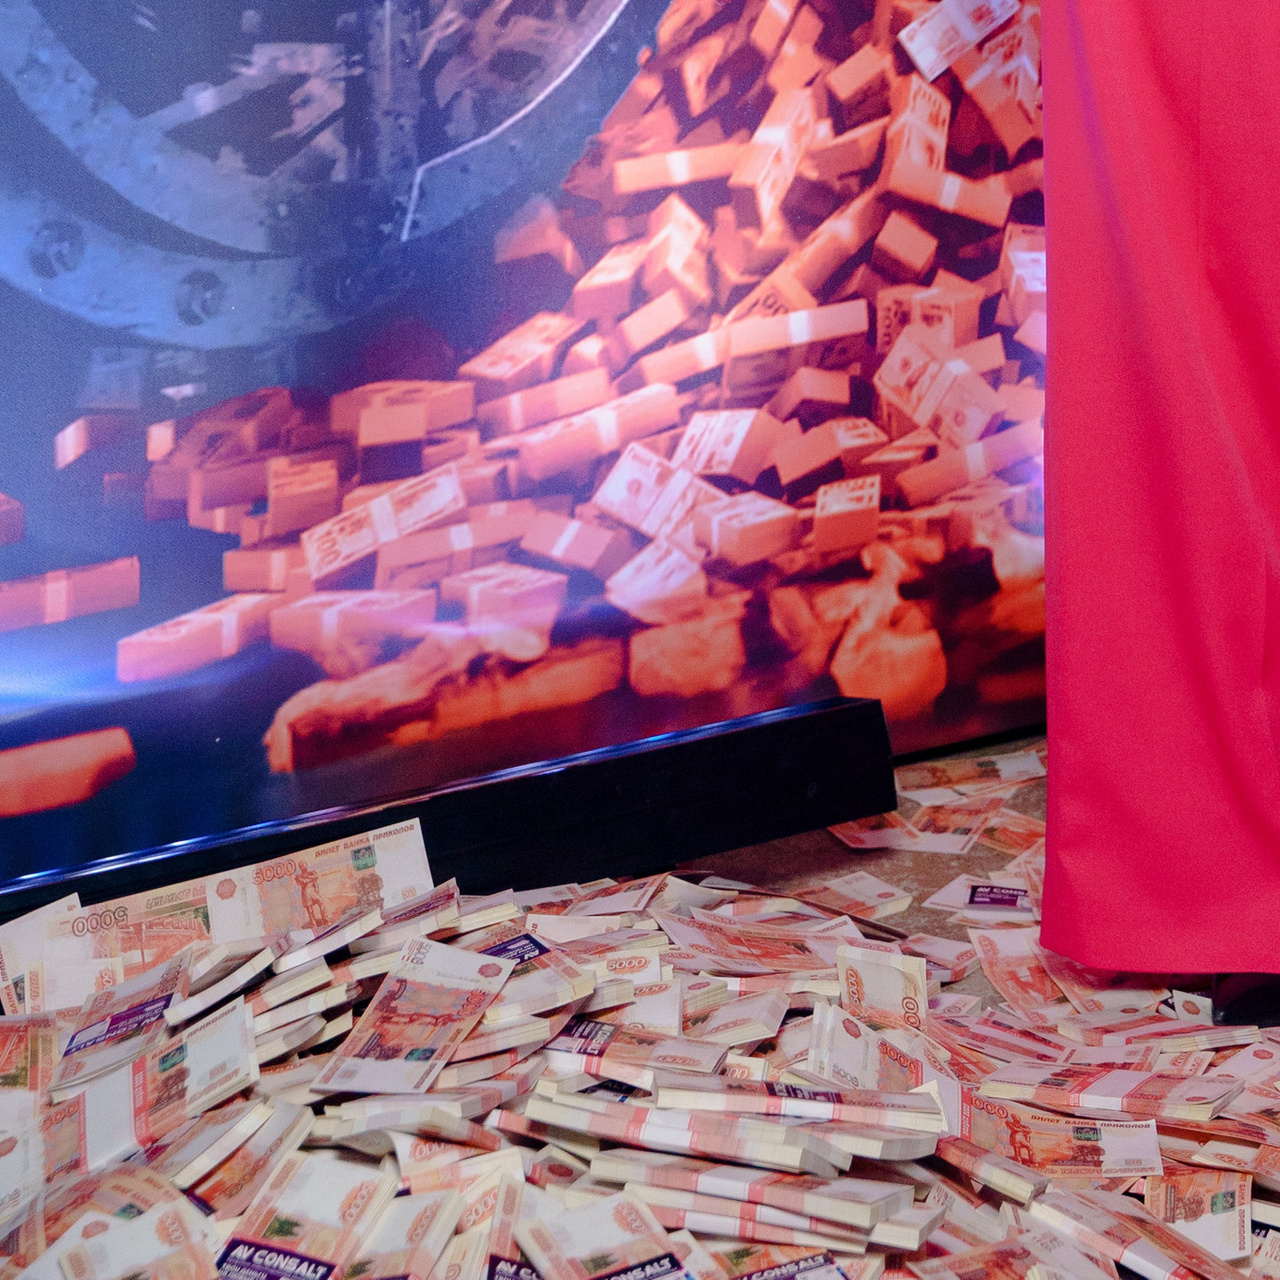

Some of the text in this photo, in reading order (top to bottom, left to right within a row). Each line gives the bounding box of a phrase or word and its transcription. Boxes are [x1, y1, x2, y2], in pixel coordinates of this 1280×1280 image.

[315, 823, 415, 858] БИЛЕТ БАНКА ПРИКОЛОВ
[253, 859, 297, 885] 5000
[72, 905, 129, 938] 5000
[607, 958, 646, 971] 5000
[848, 969, 859, 1004] 5000
[187, 1004, 238, 1039] ПРИКОЛОВ
[971, 1095, 1009, 1118] 000
[1030, 1114, 1151, 1130] БИЛЕТ БАНКА ПРИКОЛОВ
[1237, 1208, 1246, 1252] ПРИКОЛОВ
[230, 1244, 328, 1280] AV CONSALT
